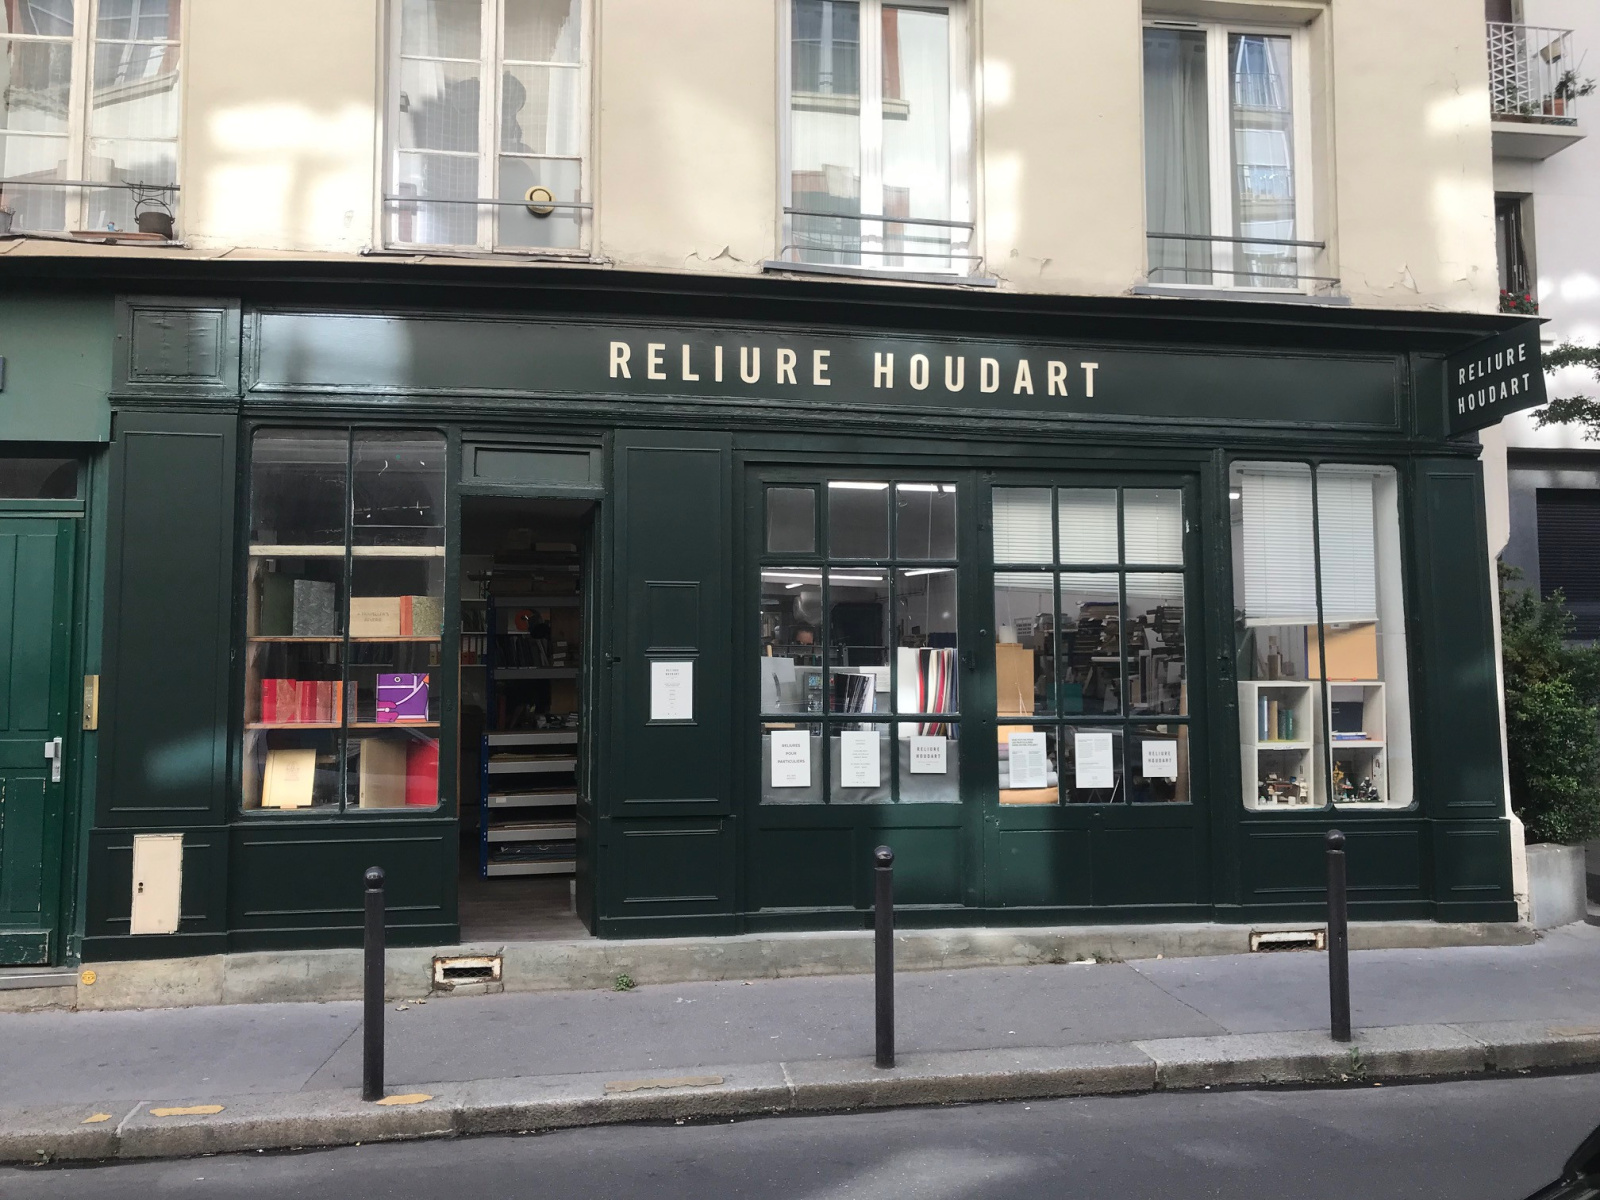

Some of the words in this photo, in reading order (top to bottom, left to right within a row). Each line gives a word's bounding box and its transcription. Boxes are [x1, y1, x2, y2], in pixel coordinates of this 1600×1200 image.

[609, 341, 831, 386] RELIURE
[873, 351, 1099, 397] HOUDART
[1459, 343, 1526, 385] RELIURE
[1458, 373, 1530, 415] HOUDART
